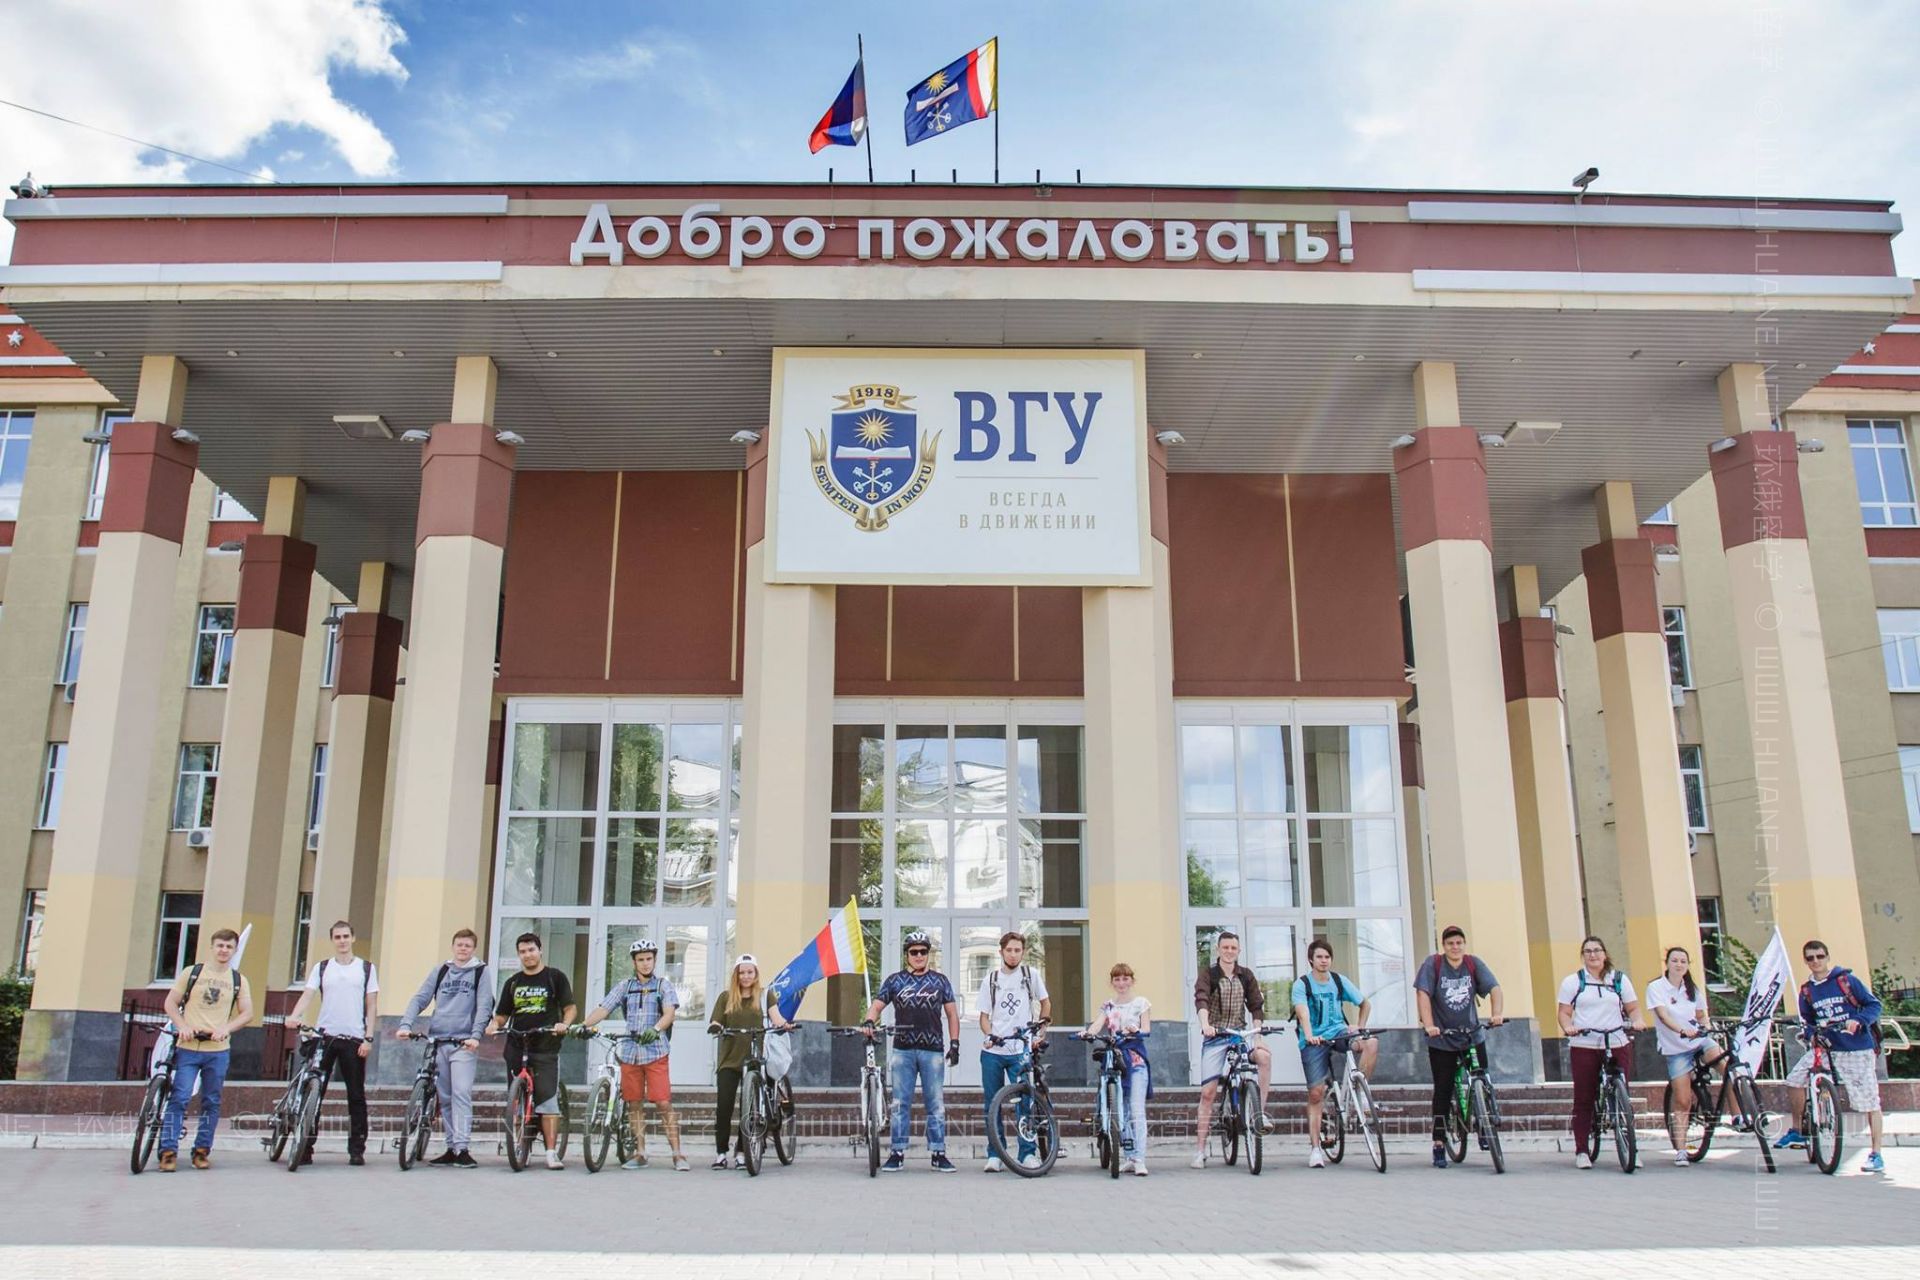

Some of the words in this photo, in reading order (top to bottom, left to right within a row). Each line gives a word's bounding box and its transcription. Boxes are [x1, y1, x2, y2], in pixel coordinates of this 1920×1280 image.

[569, 202, 828, 271] Добро
[856, 209, 1355, 265] пожаловать!
[856, 385, 894, 400] 1918
[953, 390, 1104, 465] ВГУ
[814, 463, 861, 516] SEMPER
[884, 497, 904, 516] IN
[900, 463, 933, 508] MOTU
[989, 491, 1067, 508] ВСЕГДА
[959, 513, 970, 530] В
[979, 513, 1097, 531] ДВИЖЕНИИ
